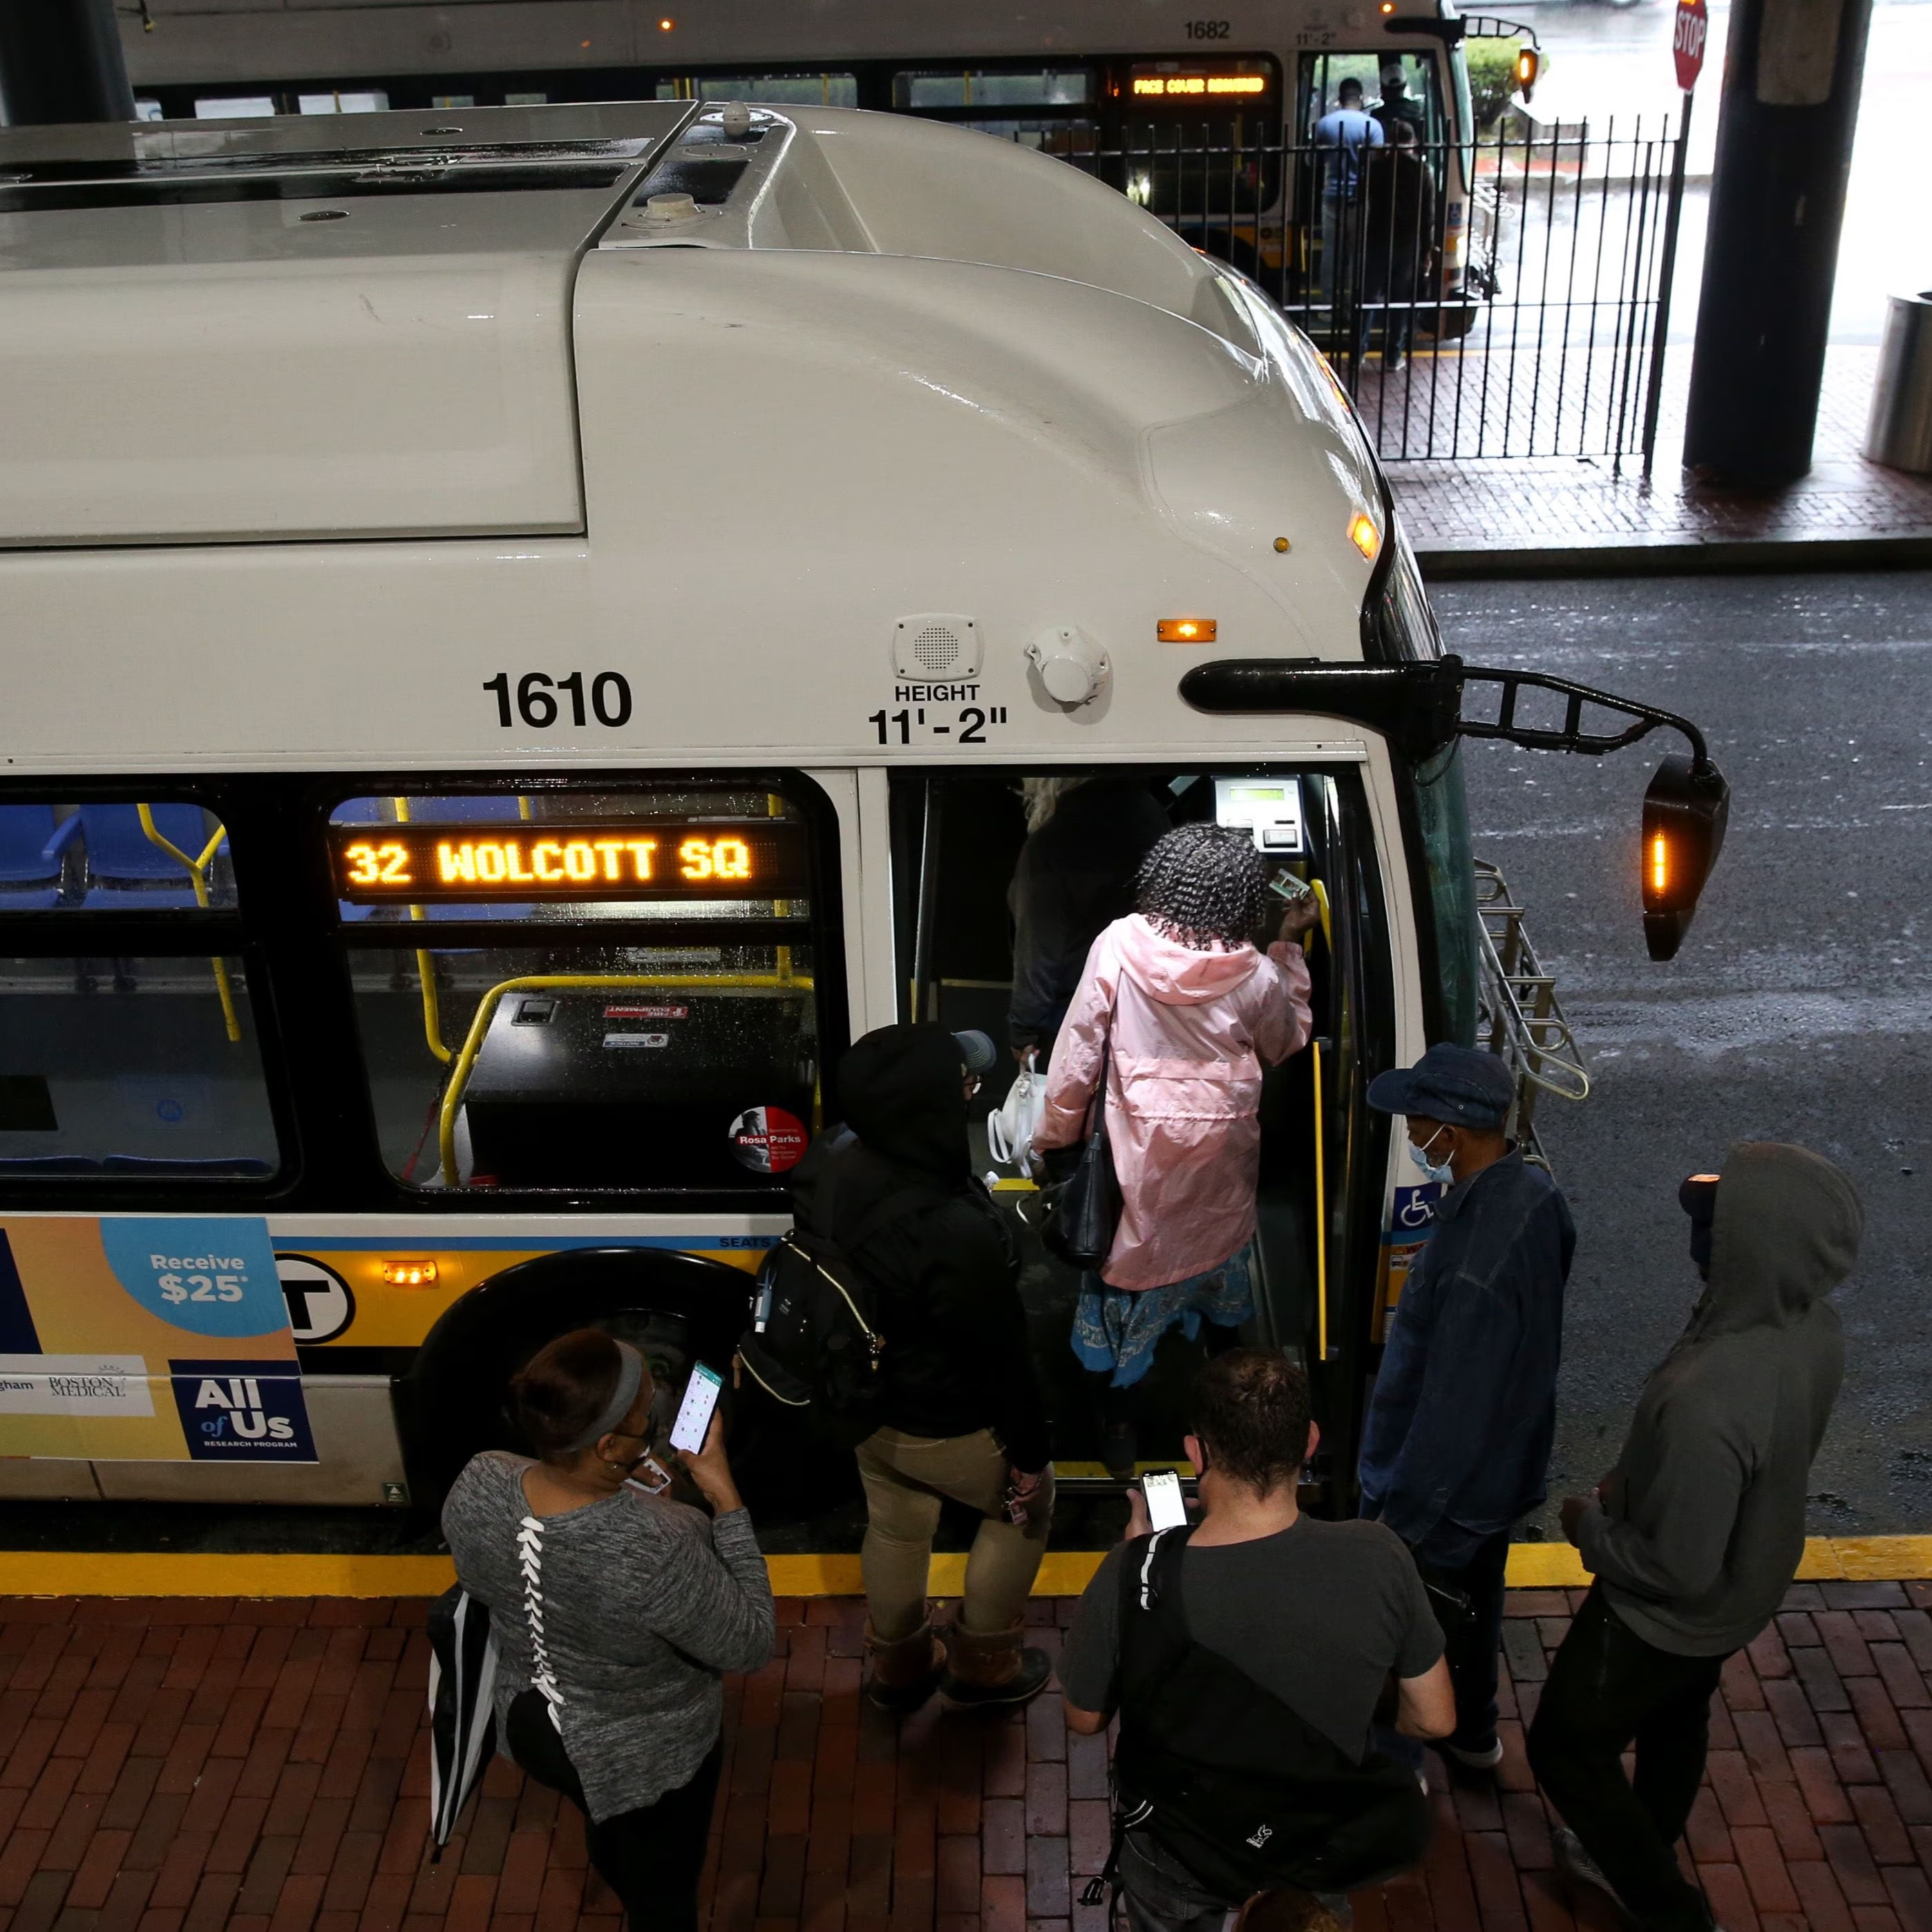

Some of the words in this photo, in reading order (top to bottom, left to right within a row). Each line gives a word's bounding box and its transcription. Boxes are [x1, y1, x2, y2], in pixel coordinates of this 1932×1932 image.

[1185, 21, 1230, 39] 1682
[1675, 10, 1706, 59] STOP
[1134, 79, 1164, 94] FACE
[483, 672, 632, 728] 1610
[895, 685, 980, 701] HEIGHT
[345, 844, 412, 883] 32
[437, 840, 657, 883] WOLCOTT
[679, 840, 750, 879] SQ
[739, 1135, 767, 1144] Rosa
[770, 1135, 801, 1143] Parks
[719, 1237, 771, 1248] SEATS
[150, 1254, 245, 1270] Receive
[280, 1280, 330, 1330] T
[48, 1377, 114, 1388] BOSTON
[51, 1385, 126, 1397] MEDICAL
[195, 1379, 262, 1408] All
[201, 1416, 228, 1437] of
[230, 1411, 294, 1439] Us
